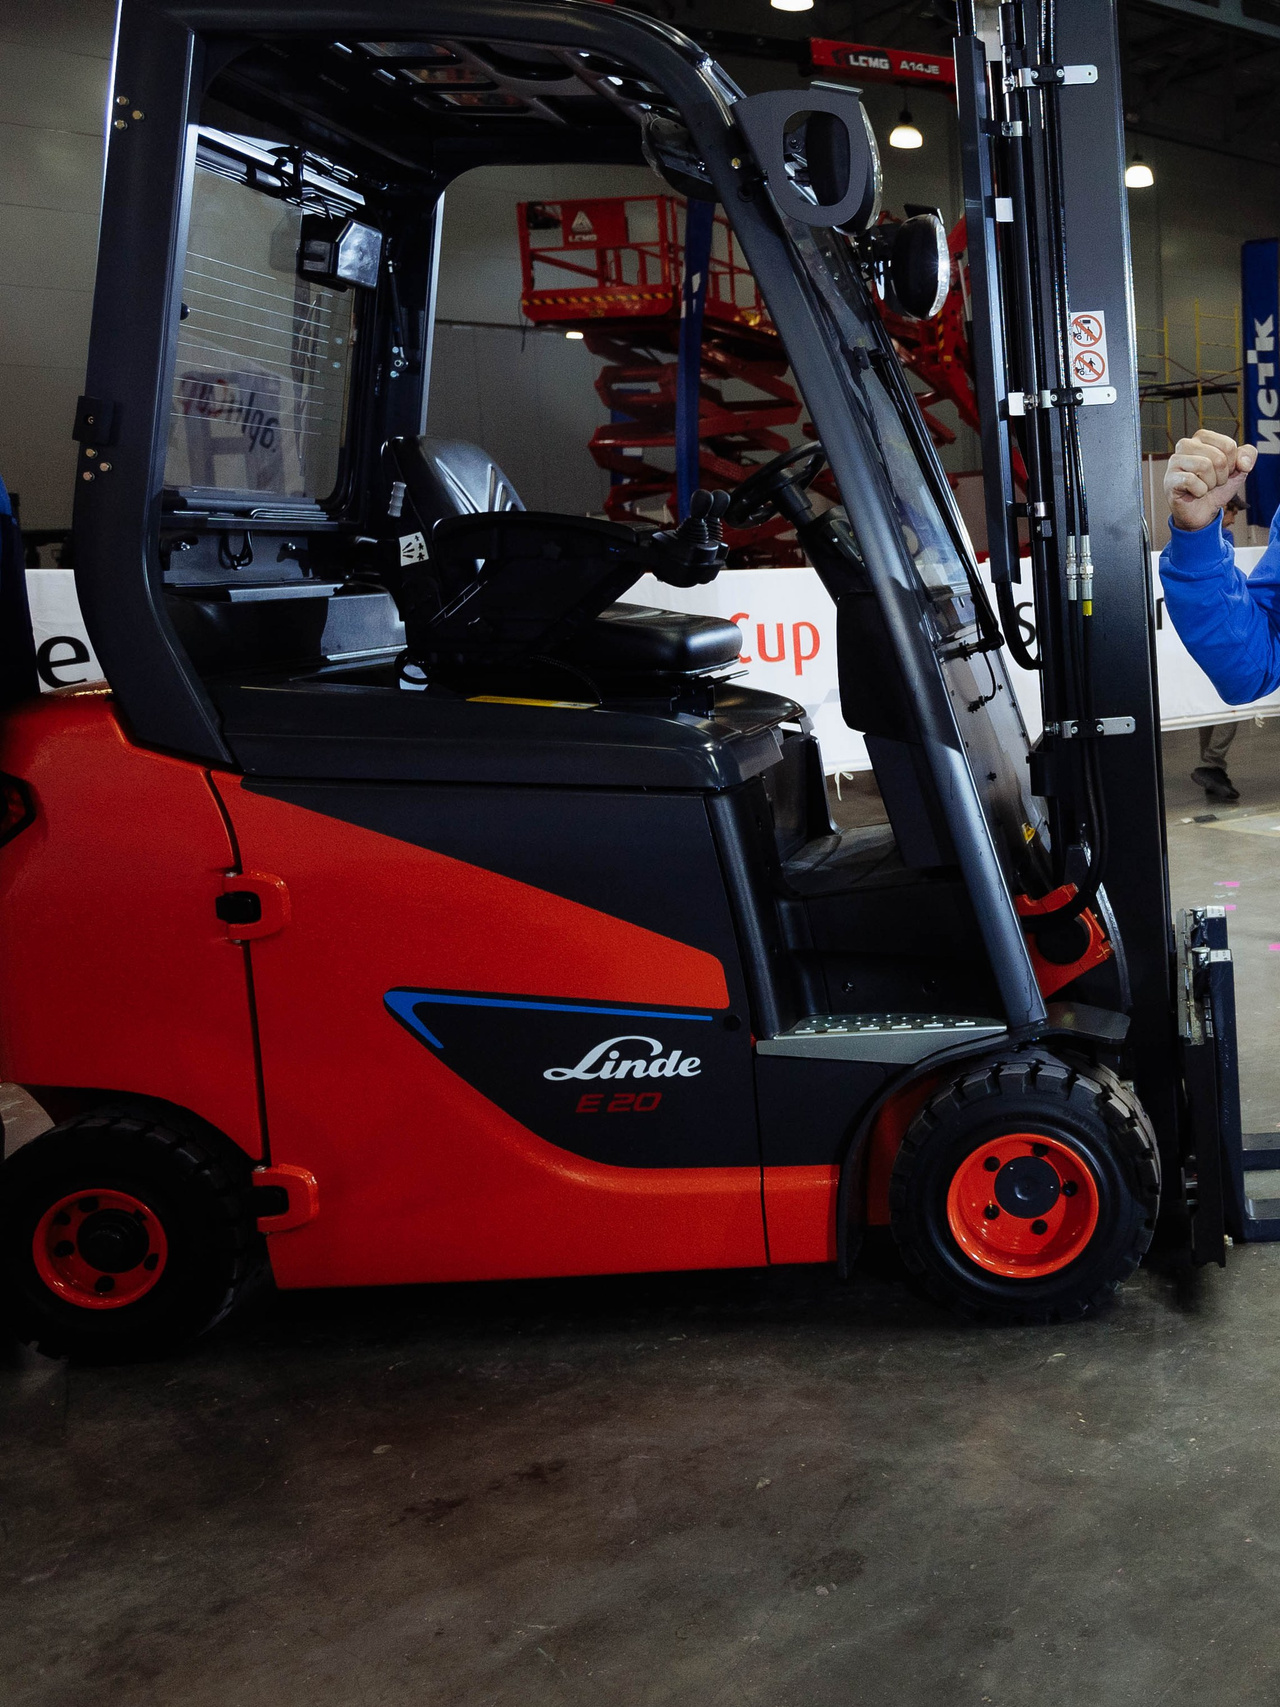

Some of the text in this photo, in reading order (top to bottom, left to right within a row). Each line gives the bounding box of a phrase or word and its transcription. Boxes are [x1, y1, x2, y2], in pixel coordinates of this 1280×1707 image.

[543, 1035, 701, 1081] Linde
[575, 1092, 663, 1113] E 20
